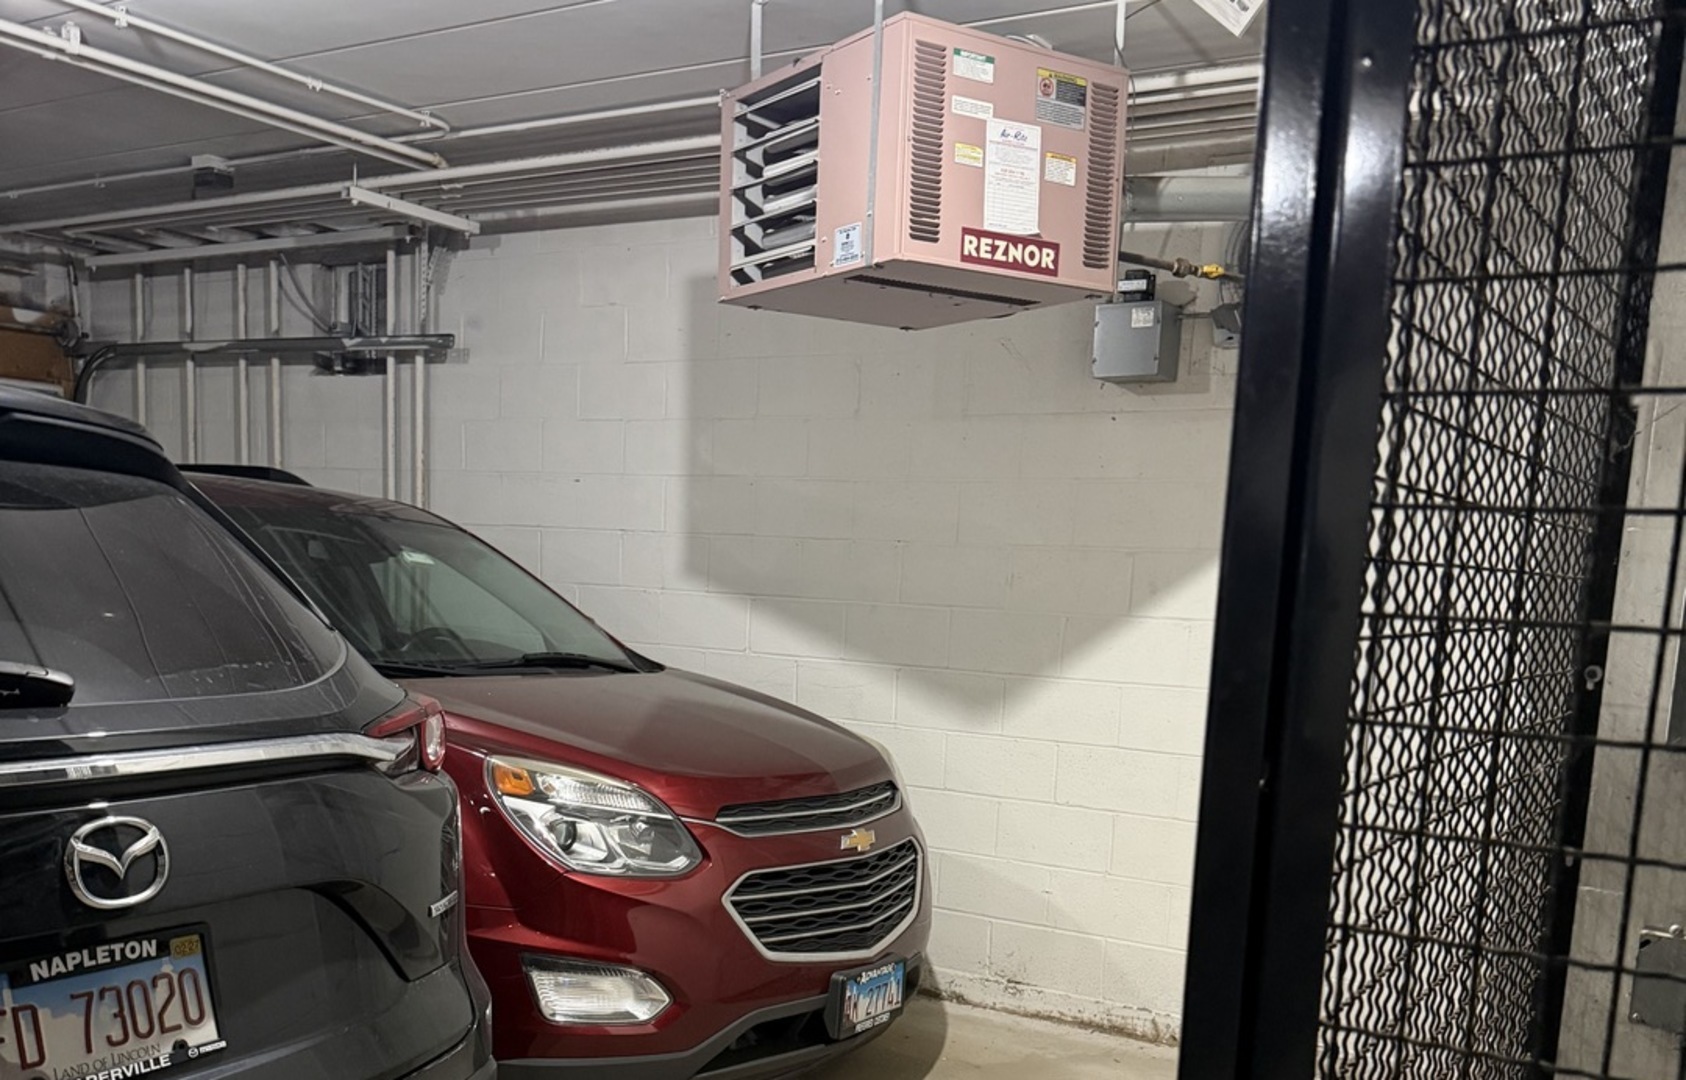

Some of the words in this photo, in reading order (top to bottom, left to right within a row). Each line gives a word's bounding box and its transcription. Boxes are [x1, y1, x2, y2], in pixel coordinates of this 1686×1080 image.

[963, 234, 1056, 270] REZNOR
[30, 939, 157, 982] NAPLETON
[866, 978, 901, 1015] 27741
[0, 1004, 46, 1071] D
[70, 967, 206, 1054] 73020
[111, 1043, 161, 1066] LINCOLN
